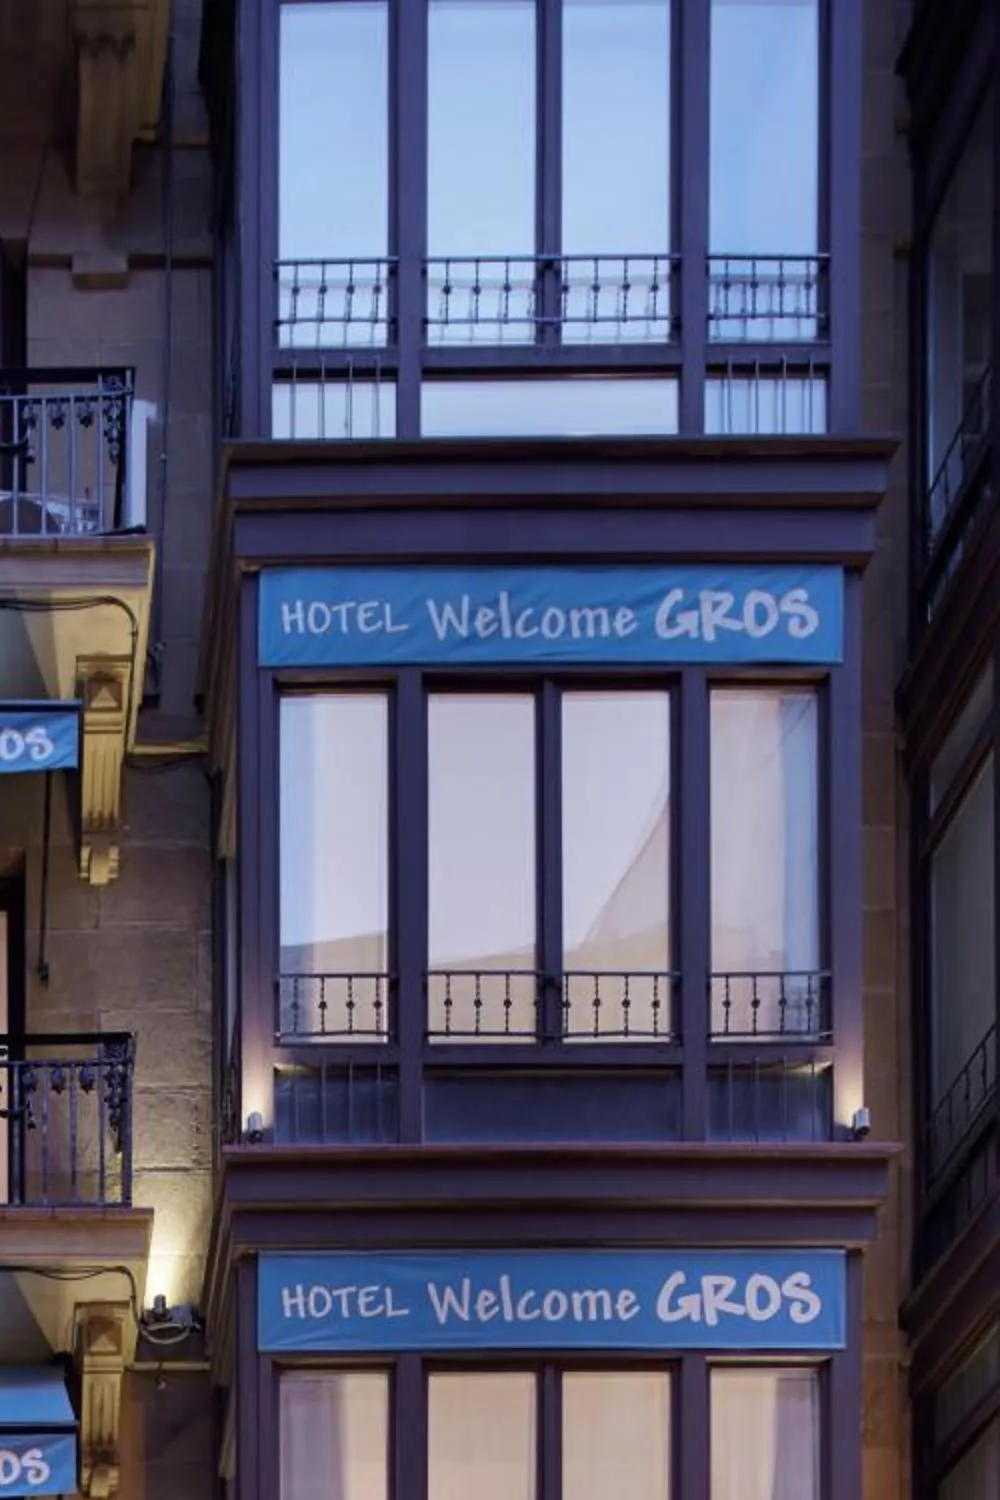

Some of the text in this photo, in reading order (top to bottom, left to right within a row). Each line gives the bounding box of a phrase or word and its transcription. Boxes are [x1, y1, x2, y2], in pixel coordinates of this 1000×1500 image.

[282, 588, 820, 641] HOTEL Welcome GROS
[282, 1271, 822, 1327] HOTEL Welcome GROS
